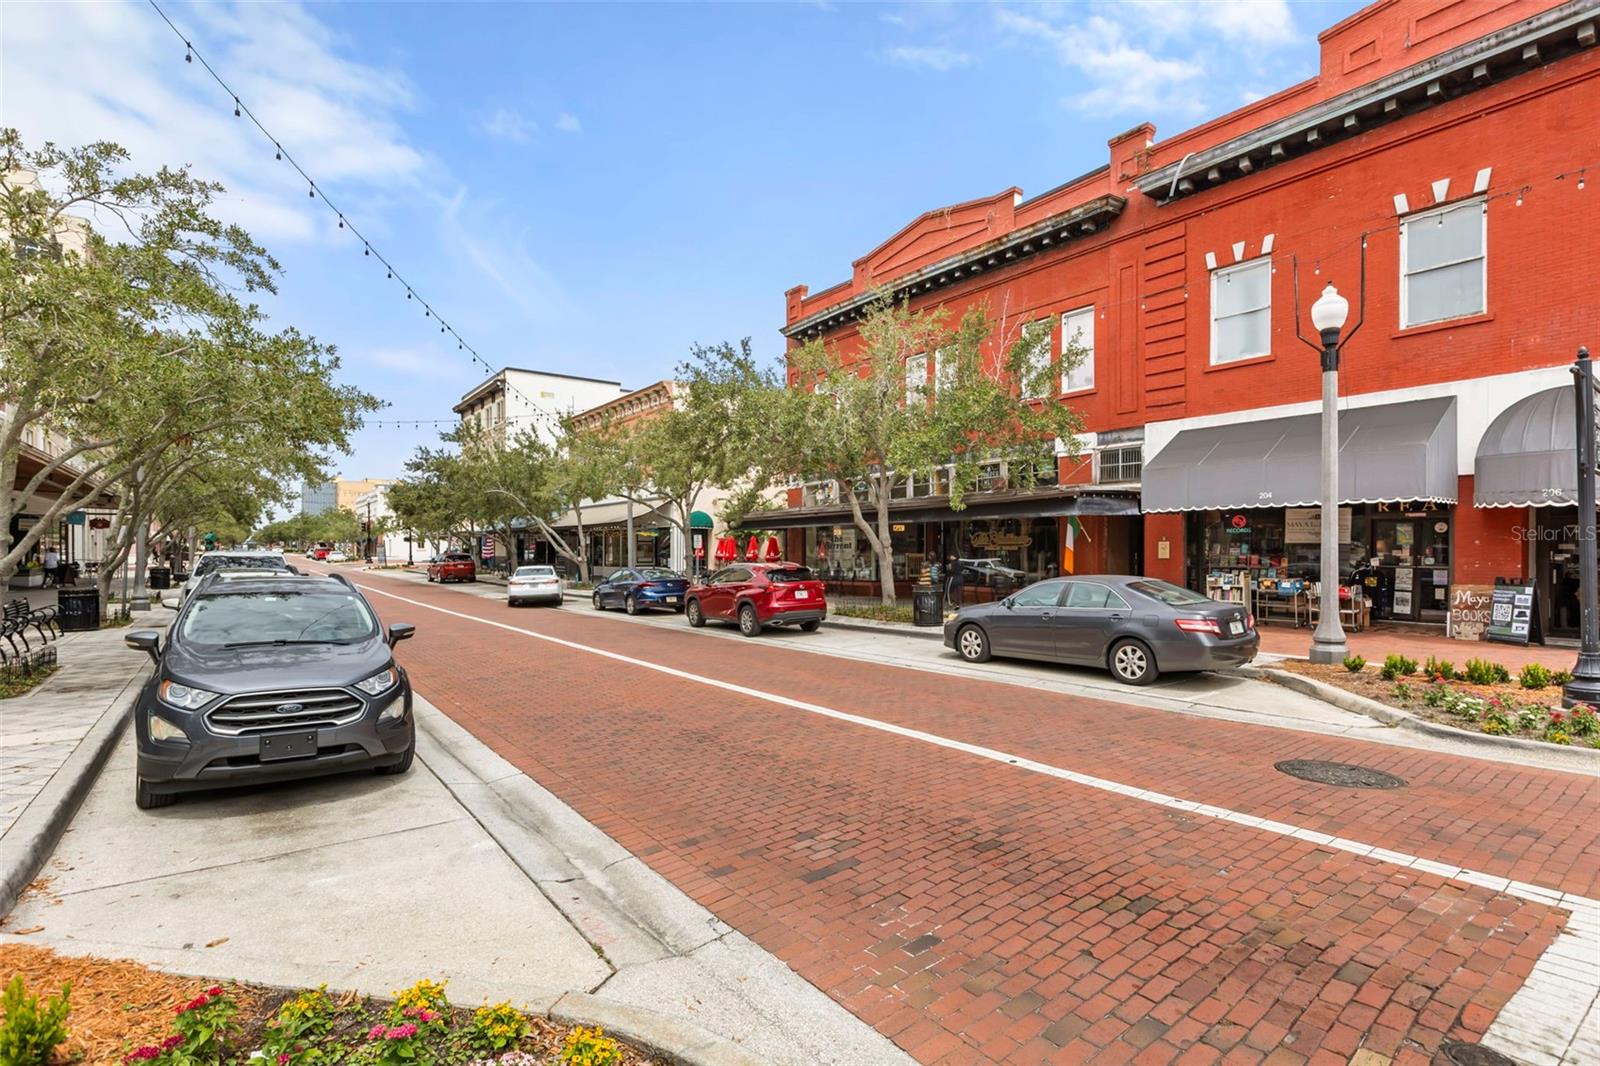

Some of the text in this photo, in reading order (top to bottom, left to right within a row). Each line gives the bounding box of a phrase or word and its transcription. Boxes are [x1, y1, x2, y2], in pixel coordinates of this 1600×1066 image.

[1541, 488, 1563, 497] 206
[1453, 589, 1491, 609] Maya
[1452, 608, 1492, 624] BOOKS
